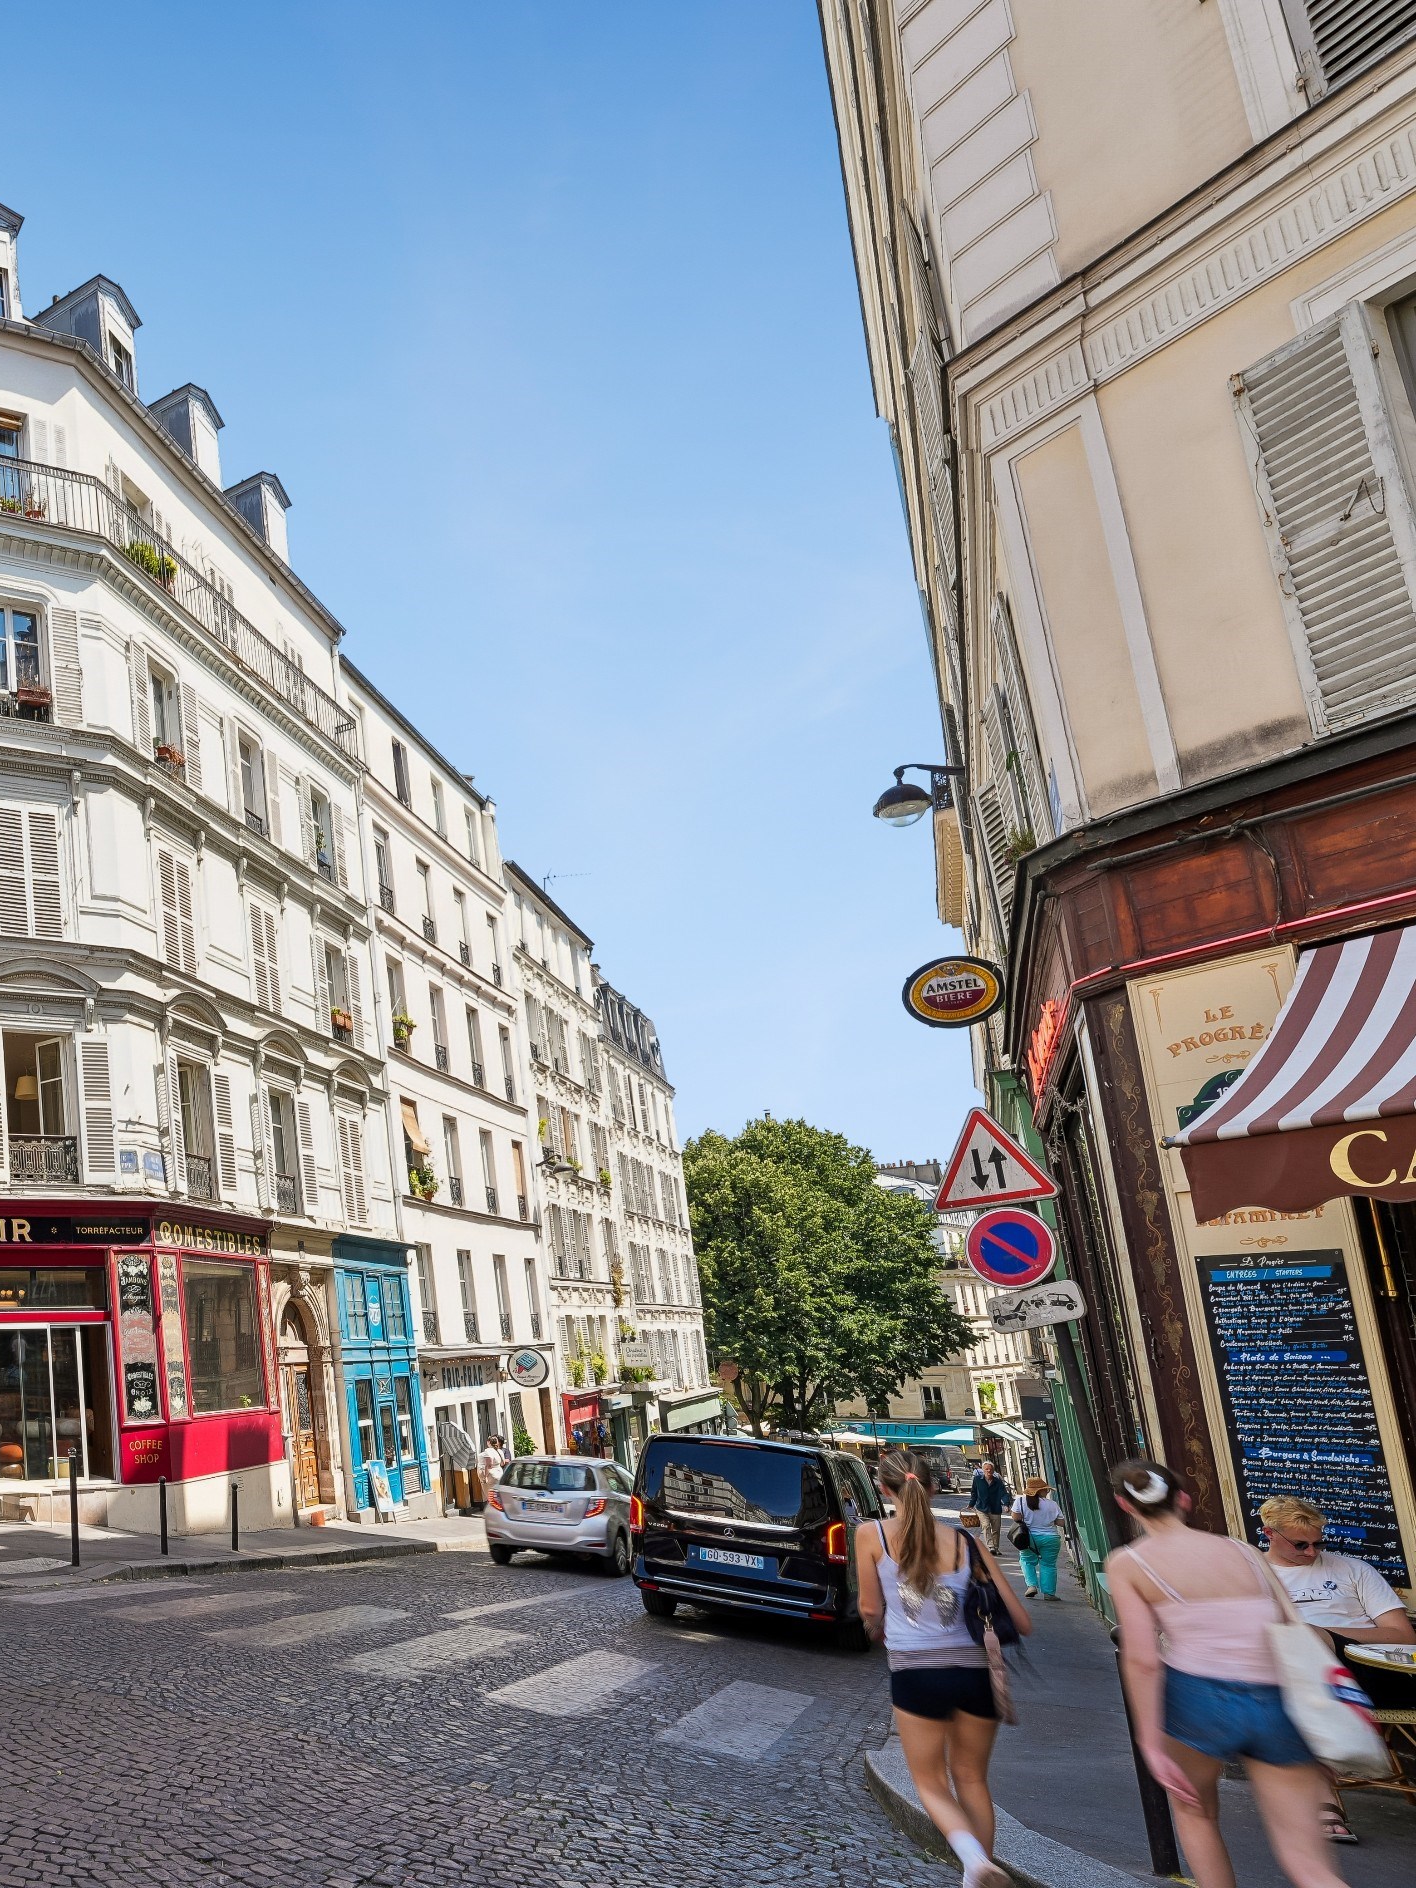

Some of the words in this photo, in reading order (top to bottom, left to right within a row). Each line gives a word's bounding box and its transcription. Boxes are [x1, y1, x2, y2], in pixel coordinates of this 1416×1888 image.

[926, 978, 981, 994] AMSTEL
[936, 991, 973, 1003] BIERE
[1204, 1006, 1234, 1023] LE
[159, 1221, 261, 1256] COMESTIBLES
[1226, 1269, 1257, 1279] ENTRÉES
[1240, 1352, 1266, 1362] Plats
[1269, 1353, 1280, 1361] de
[1283, 1352, 1313, 1361] Saison
[129, 1440, 163, 1451] COFFEE
[135, 1453, 160, 1464] SHOP
[1258, 1447, 1300, 1460] Burgers
[1302, 1452, 1310, 1461] &
[1311, 1450, 1360, 1464] Sandwichs
